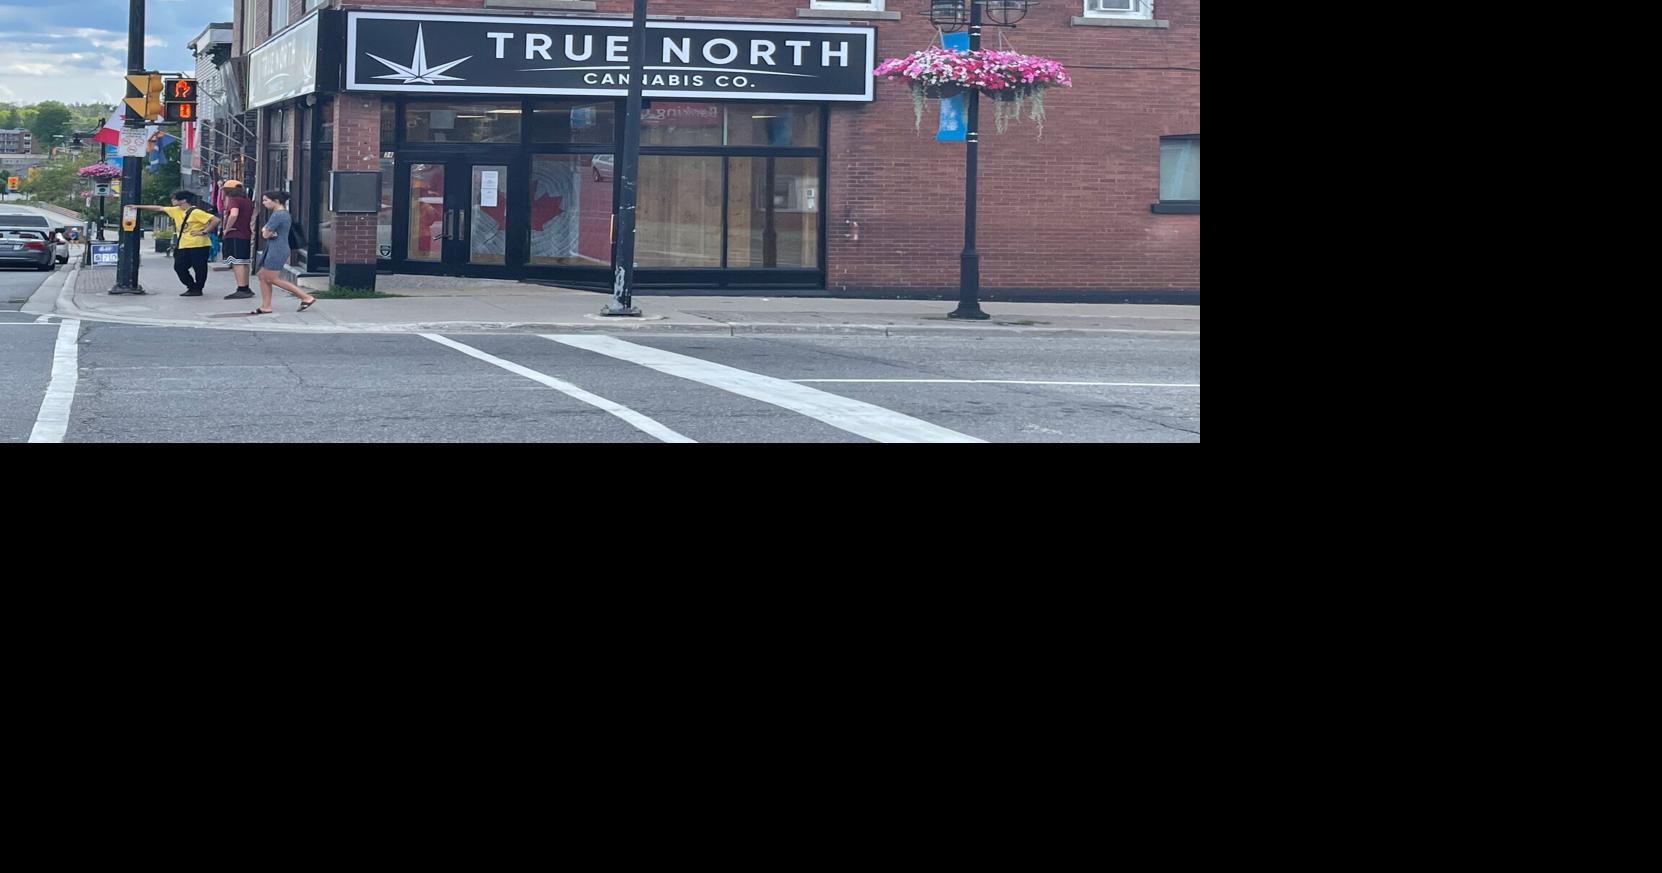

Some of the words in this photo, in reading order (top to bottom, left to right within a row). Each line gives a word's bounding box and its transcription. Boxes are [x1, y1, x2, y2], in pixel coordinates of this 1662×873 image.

[487, 32, 629, 62] TRUE
[662, 37, 849, 67] NORTH
[715, 75, 756, 88] CO.
